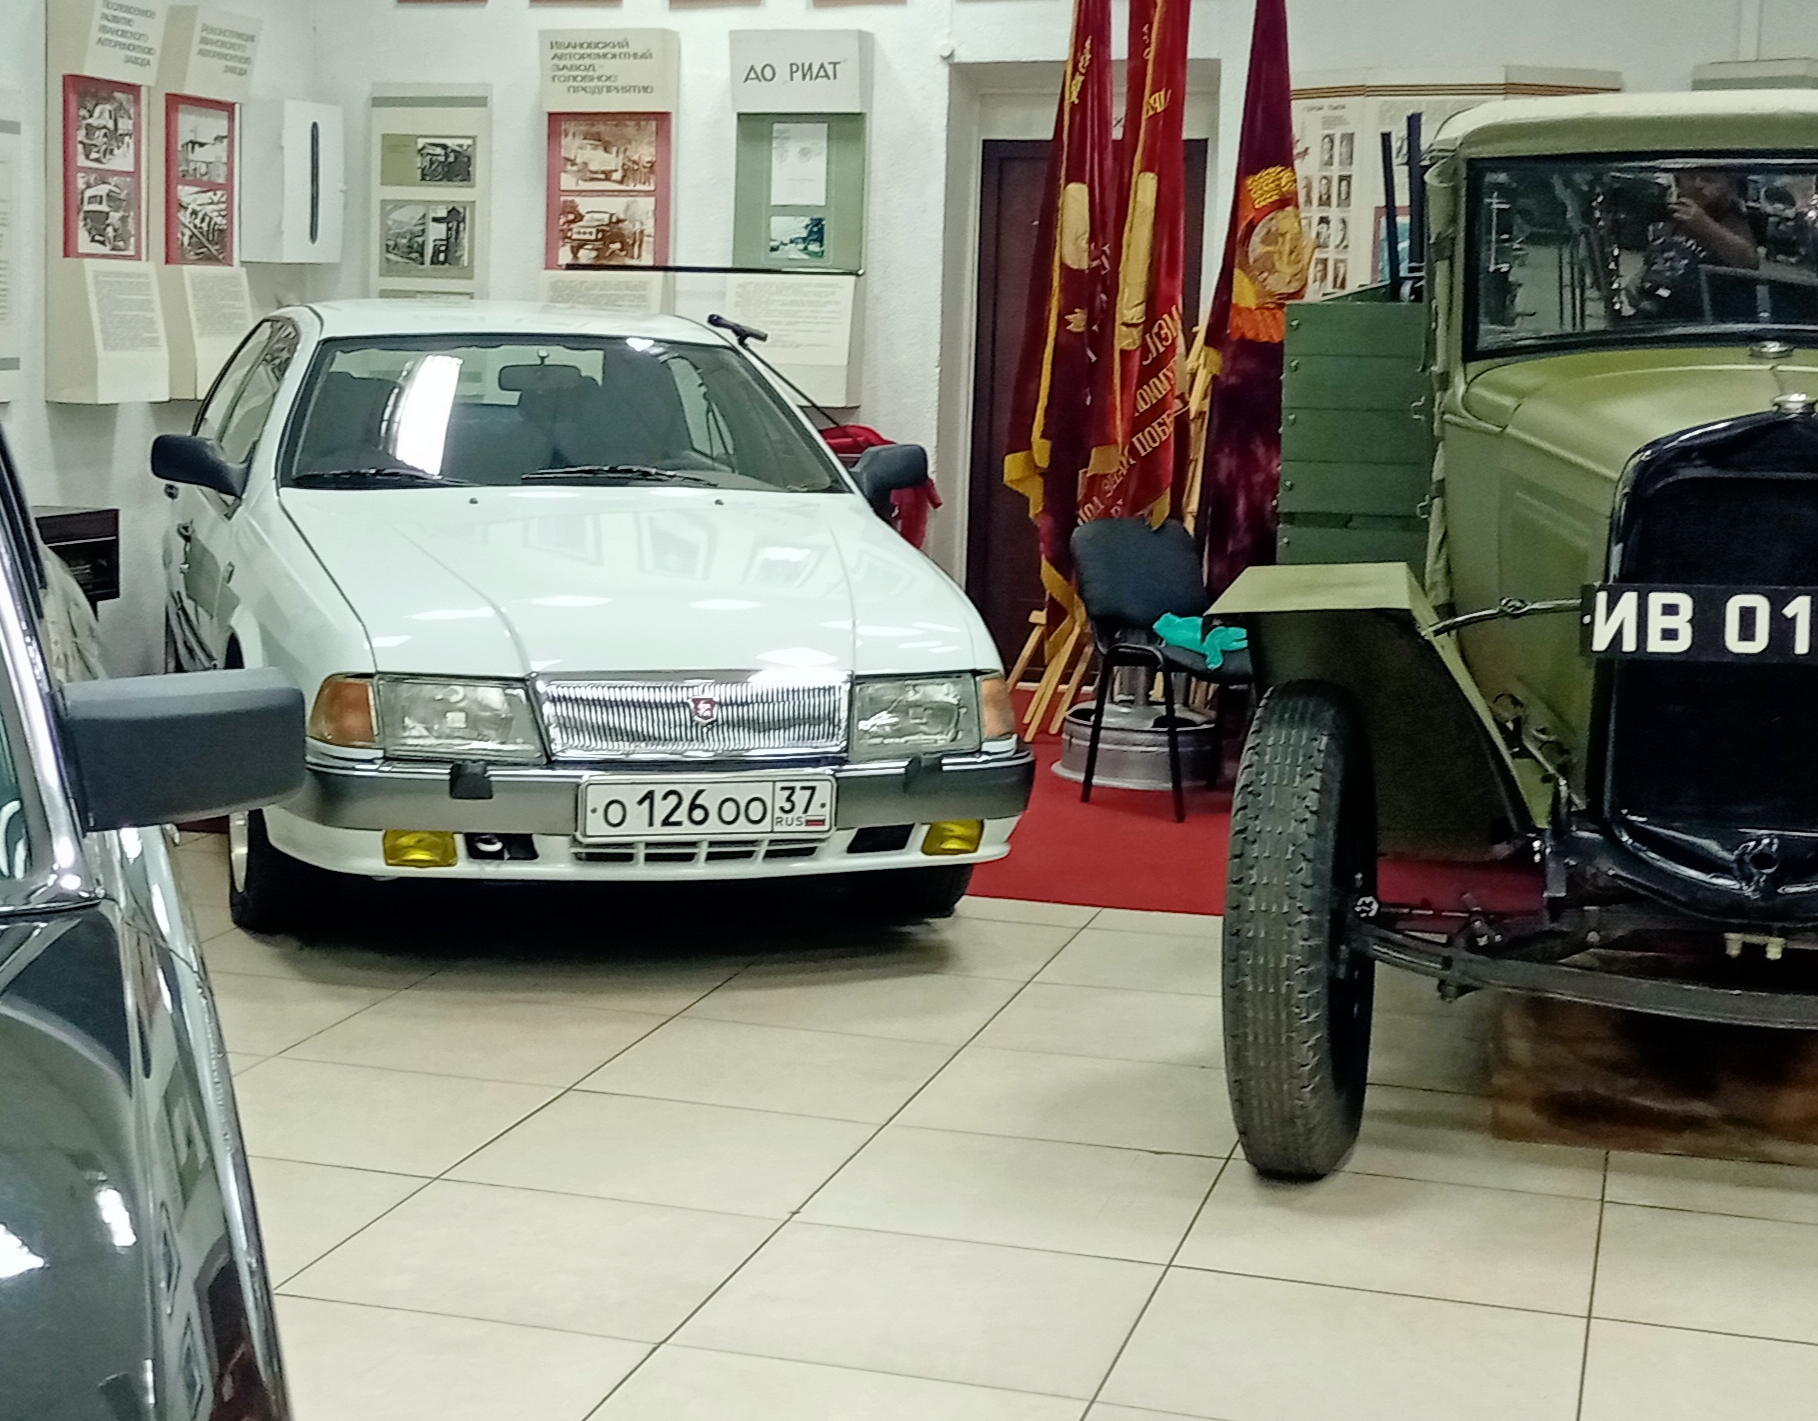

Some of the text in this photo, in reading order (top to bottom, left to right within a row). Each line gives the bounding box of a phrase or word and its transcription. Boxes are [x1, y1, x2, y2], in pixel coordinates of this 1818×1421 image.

[549, 38, 630, 50] ИВАНОВСКИЙ
[551, 48, 653, 60] АВТОРЕМОНТНЫЙ
[551, 63, 596, 73] ЗАВОД
[1592, 590, 1812, 655] ИВ 01
[778, 786, 817, 814] 37
[775, 816, 804, 827] RUS
